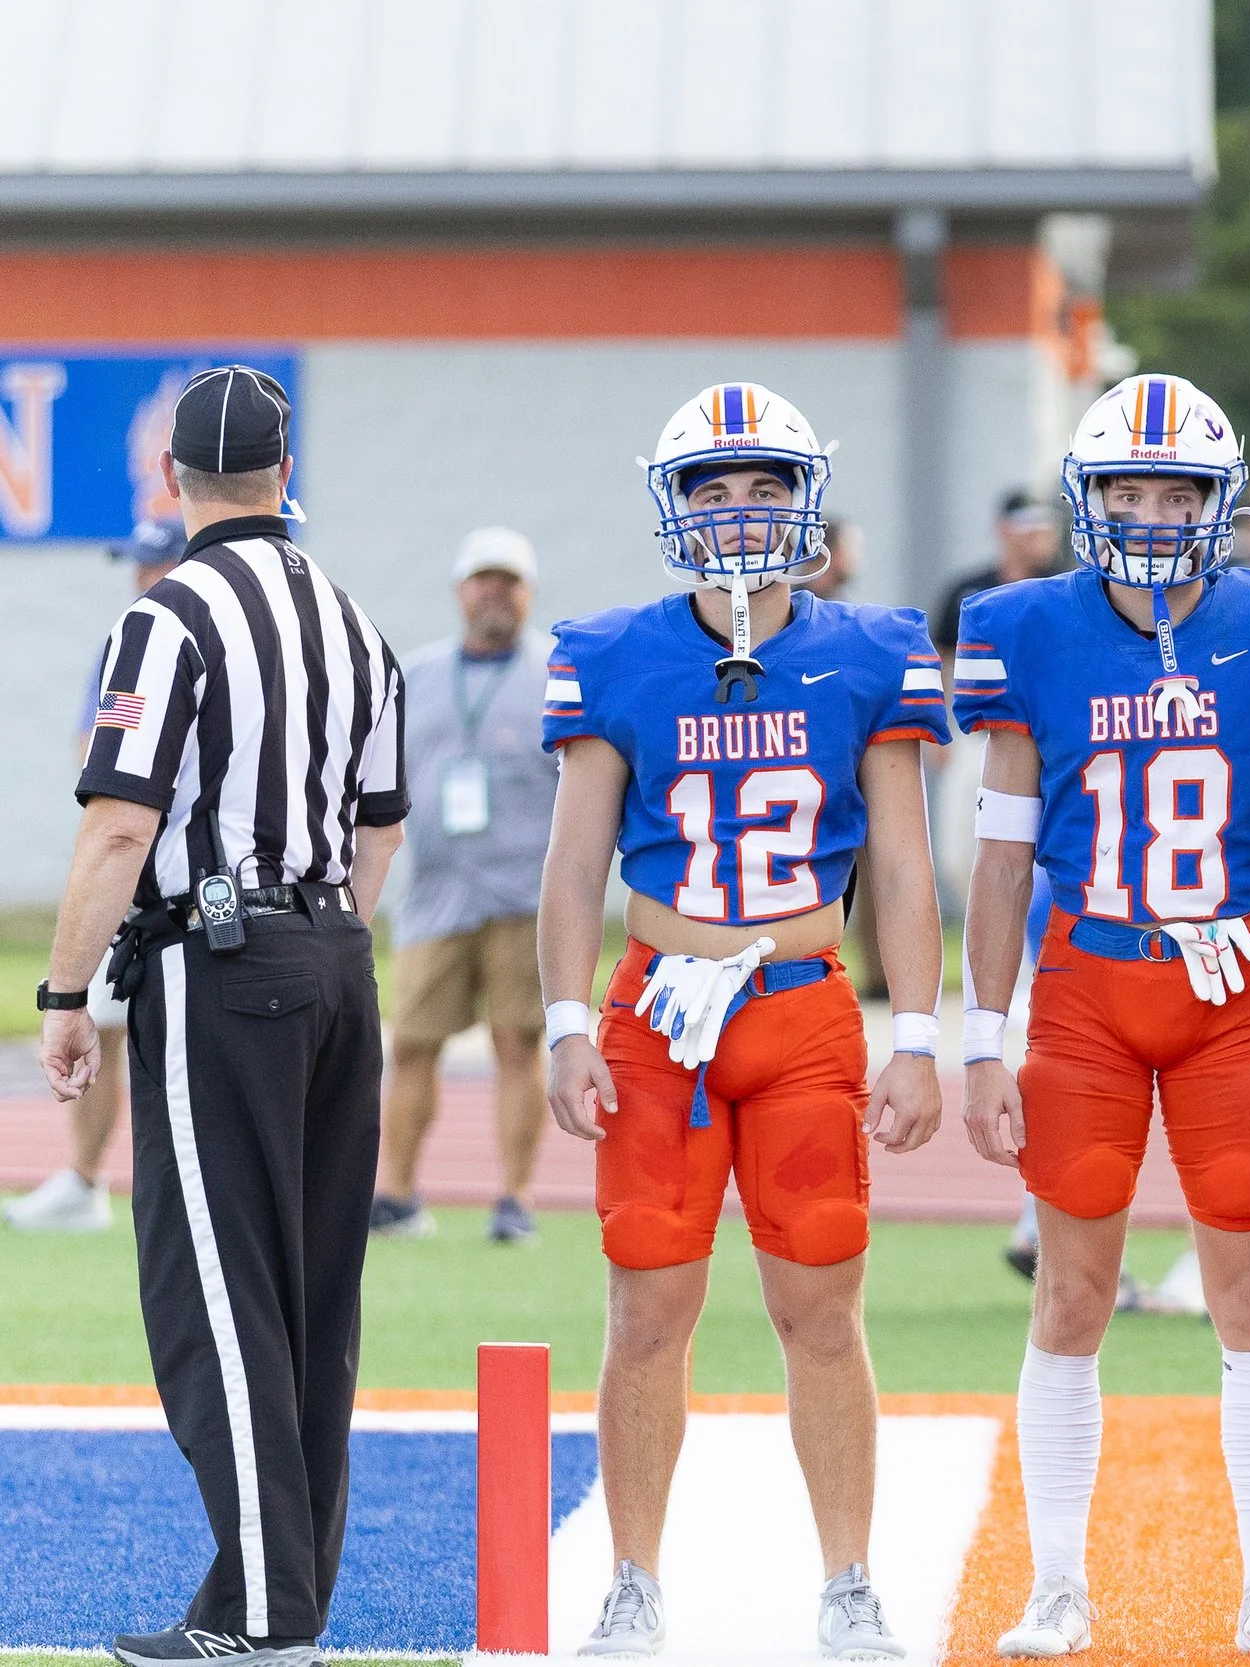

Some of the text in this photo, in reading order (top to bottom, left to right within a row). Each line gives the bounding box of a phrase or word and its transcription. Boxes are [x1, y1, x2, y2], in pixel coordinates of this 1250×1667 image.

[714, 438, 760, 449] Riddell
[1130, 449, 1177, 460] Riddell
[1160, 622, 1175, 670] BATTLE
[677, 710, 808, 762] BRUINS
[666, 765, 827, 922] 12
[1080, 744, 1233, 922] 18
